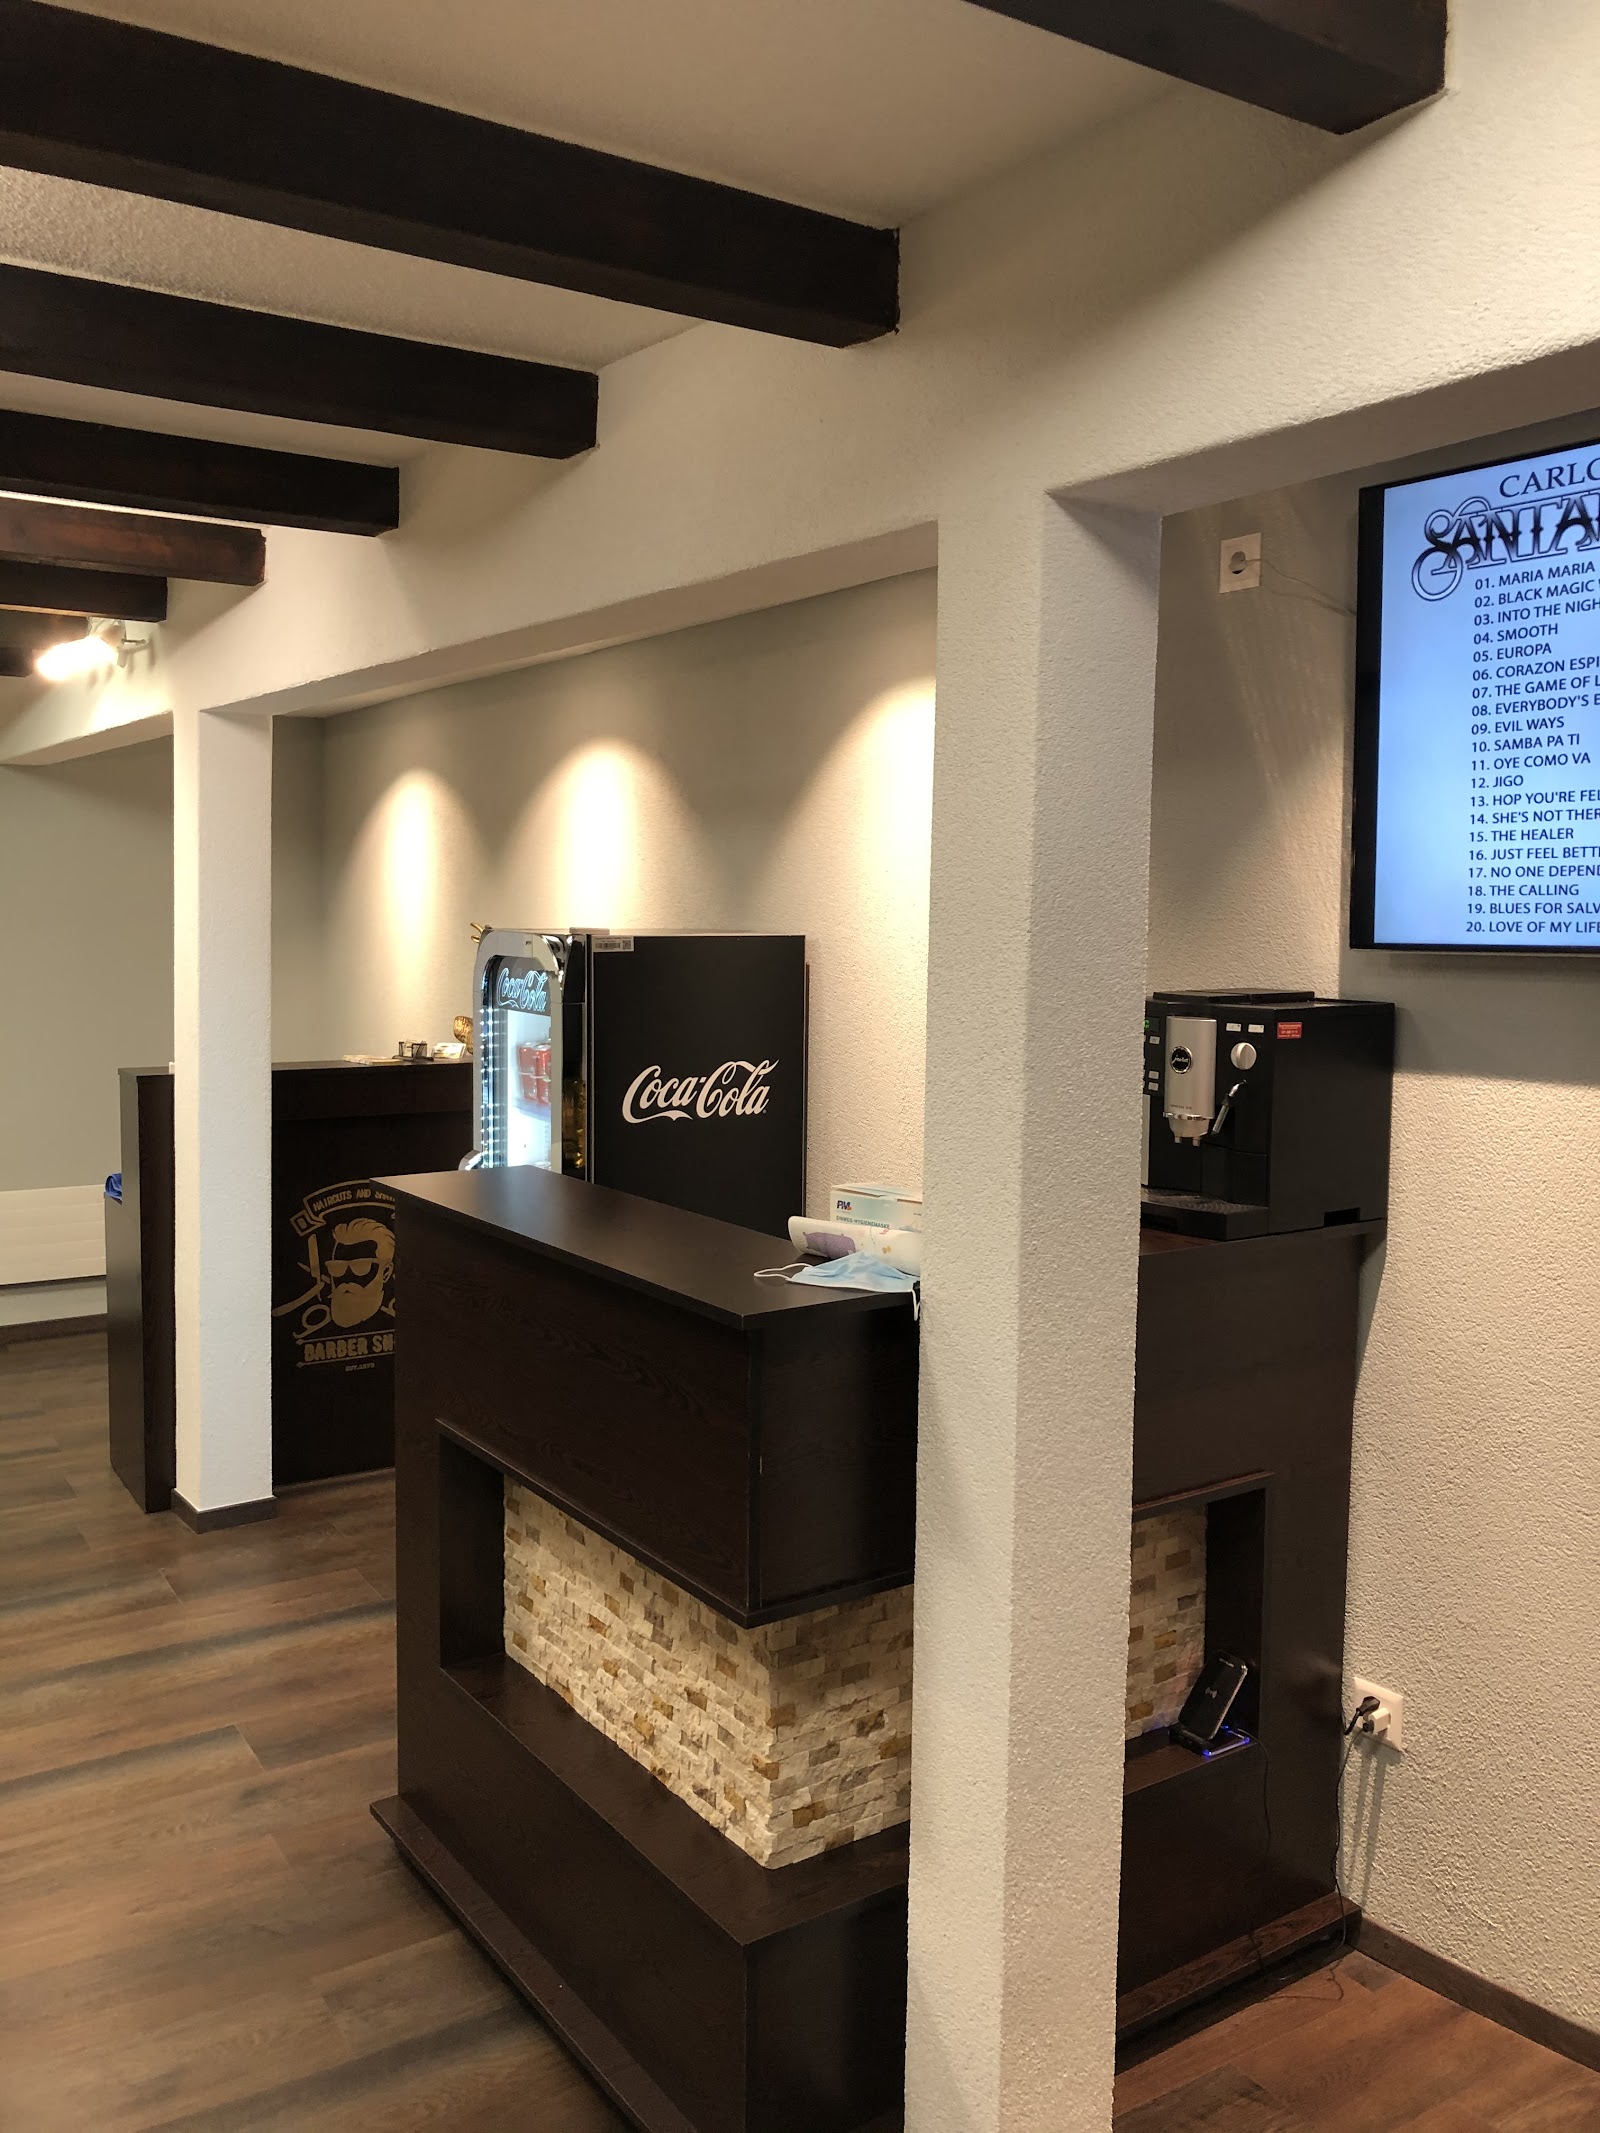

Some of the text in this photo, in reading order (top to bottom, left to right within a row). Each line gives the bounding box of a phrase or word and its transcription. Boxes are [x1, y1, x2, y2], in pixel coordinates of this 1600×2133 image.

[1412, 488, 1600, 601] SANTA
[1475, 561, 1595, 590] 01. MARIA MARIA
[1474, 596, 1494, 608] 02.
[1498, 588, 1542, 605] BLACK
[1546, 579, 1595, 598] MAGIC
[1474, 613, 1494, 626] 03.
[1498, 608, 1531, 623] INTO
[1534, 603, 1561, 618] THE
[1474, 623, 1559, 645] 04. SMOOTH
[1473, 643, 1552, 662] 05. EUROPA
[1473, 669, 1492, 681] 06.
[1496, 660, 1565, 679] CORAZON
[1472, 687, 1492, 699] 07.
[1495, 683, 1521, 697] THE
[1525, 678, 1567, 694] GAME
[1571, 675, 1590, 689] OF
[1472, 705, 1491, 717] 08.
[1495, 694, 1590, 714] EVERYBODY'S
[1471, 716, 1565, 735] 09. EVIL WAYS
[1472, 733, 1580, 753] 10. SAMBA PA TI
[1472, 752, 1591, 771] 11. OYE COMO VA
[1471, 775, 1524, 789] 12. JIGO
[1470, 796, 1489, 807] 13.
[1493, 794, 1522, 806] HOP
[1526, 791, 1575, 804] YOU'RE
[1470, 813, 1488, 825] 14.
[1492, 811, 1529, 824] SHE'S
[1533, 809, 1563, 822] NOT
[1470, 828, 1574, 842] 15. THE HEALER
[1469, 846, 1600, 860] 16. JUST FEEL BETT
[1468, 867, 1487, 878] 17.
[1491, 866, 1511, 878] NO
[1515, 866, 1545, 878] ONE
[1468, 884, 1579, 897] 18. THE CALLING
[1467, 903, 1486, 914] 19.
[1490, 903, 1531, 914] BLUES
[1535, 903, 1563, 914] FOR
[1466, 921, 1486, 933] 20.
[1489, 921, 1523, 933] LOVE
[1527, 921, 1546, 933] OF
[1550, 922, 1572, 933] MY
[497, 968, 548, 1012] Coca-Cola
[622, 1059, 779, 1124] Coca-Cola
[313, 1190, 352, 1212] HAIRCUTS
[356, 1188, 372, 1199] AND
[304, 1337, 368, 1362] BARBER
